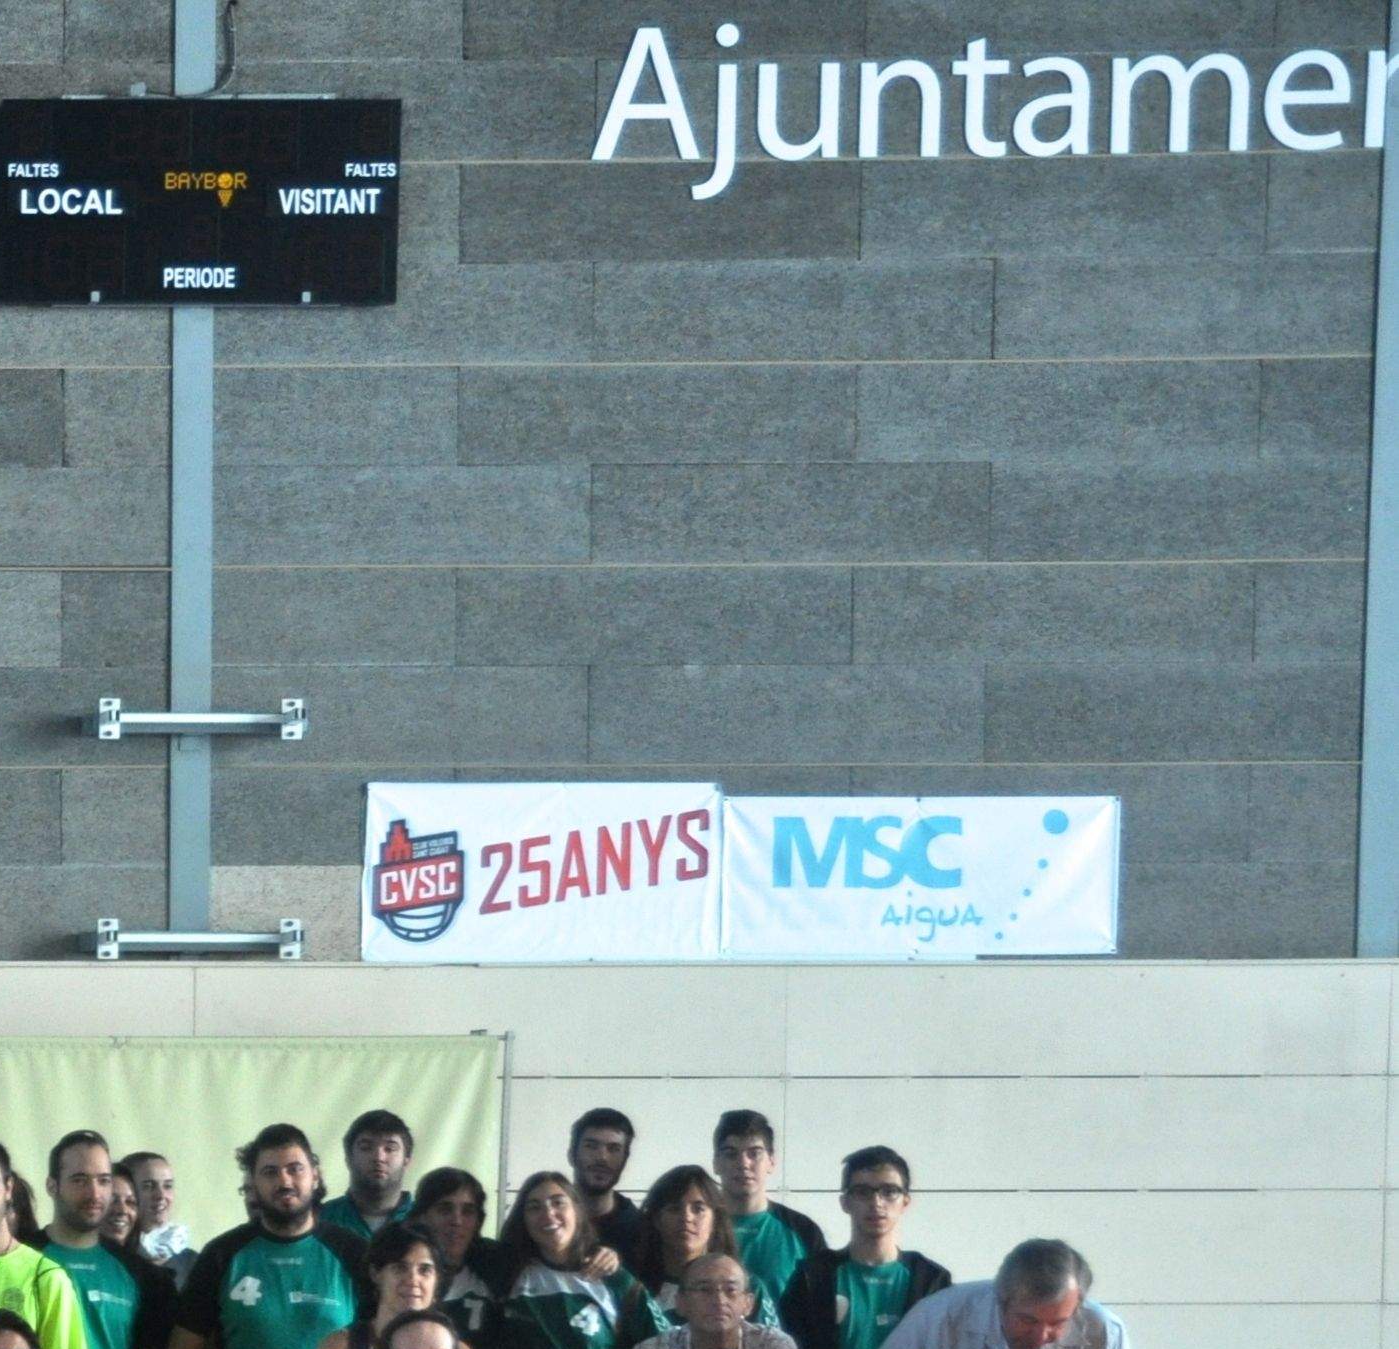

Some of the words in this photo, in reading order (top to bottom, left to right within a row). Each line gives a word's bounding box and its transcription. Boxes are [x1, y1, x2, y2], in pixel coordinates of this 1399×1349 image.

[7, 163, 59, 178] FALTES
[164, 172, 248, 191] BAYBOR
[345, 162, 397, 178] FALTES
[20, 188, 123, 216] LOCAL
[279, 188, 381, 215] VISITANT
[163, 267, 236, 289] PERIODE
[479, 808, 711, 917] 25ANYS
[772, 815, 964, 890] MSC
[380, 861, 457, 905] CVSC
[229, 1275, 262, 1307] 4
[463, 1297, 484, 1331] 7
[569, 1302, 601, 1337] 4
